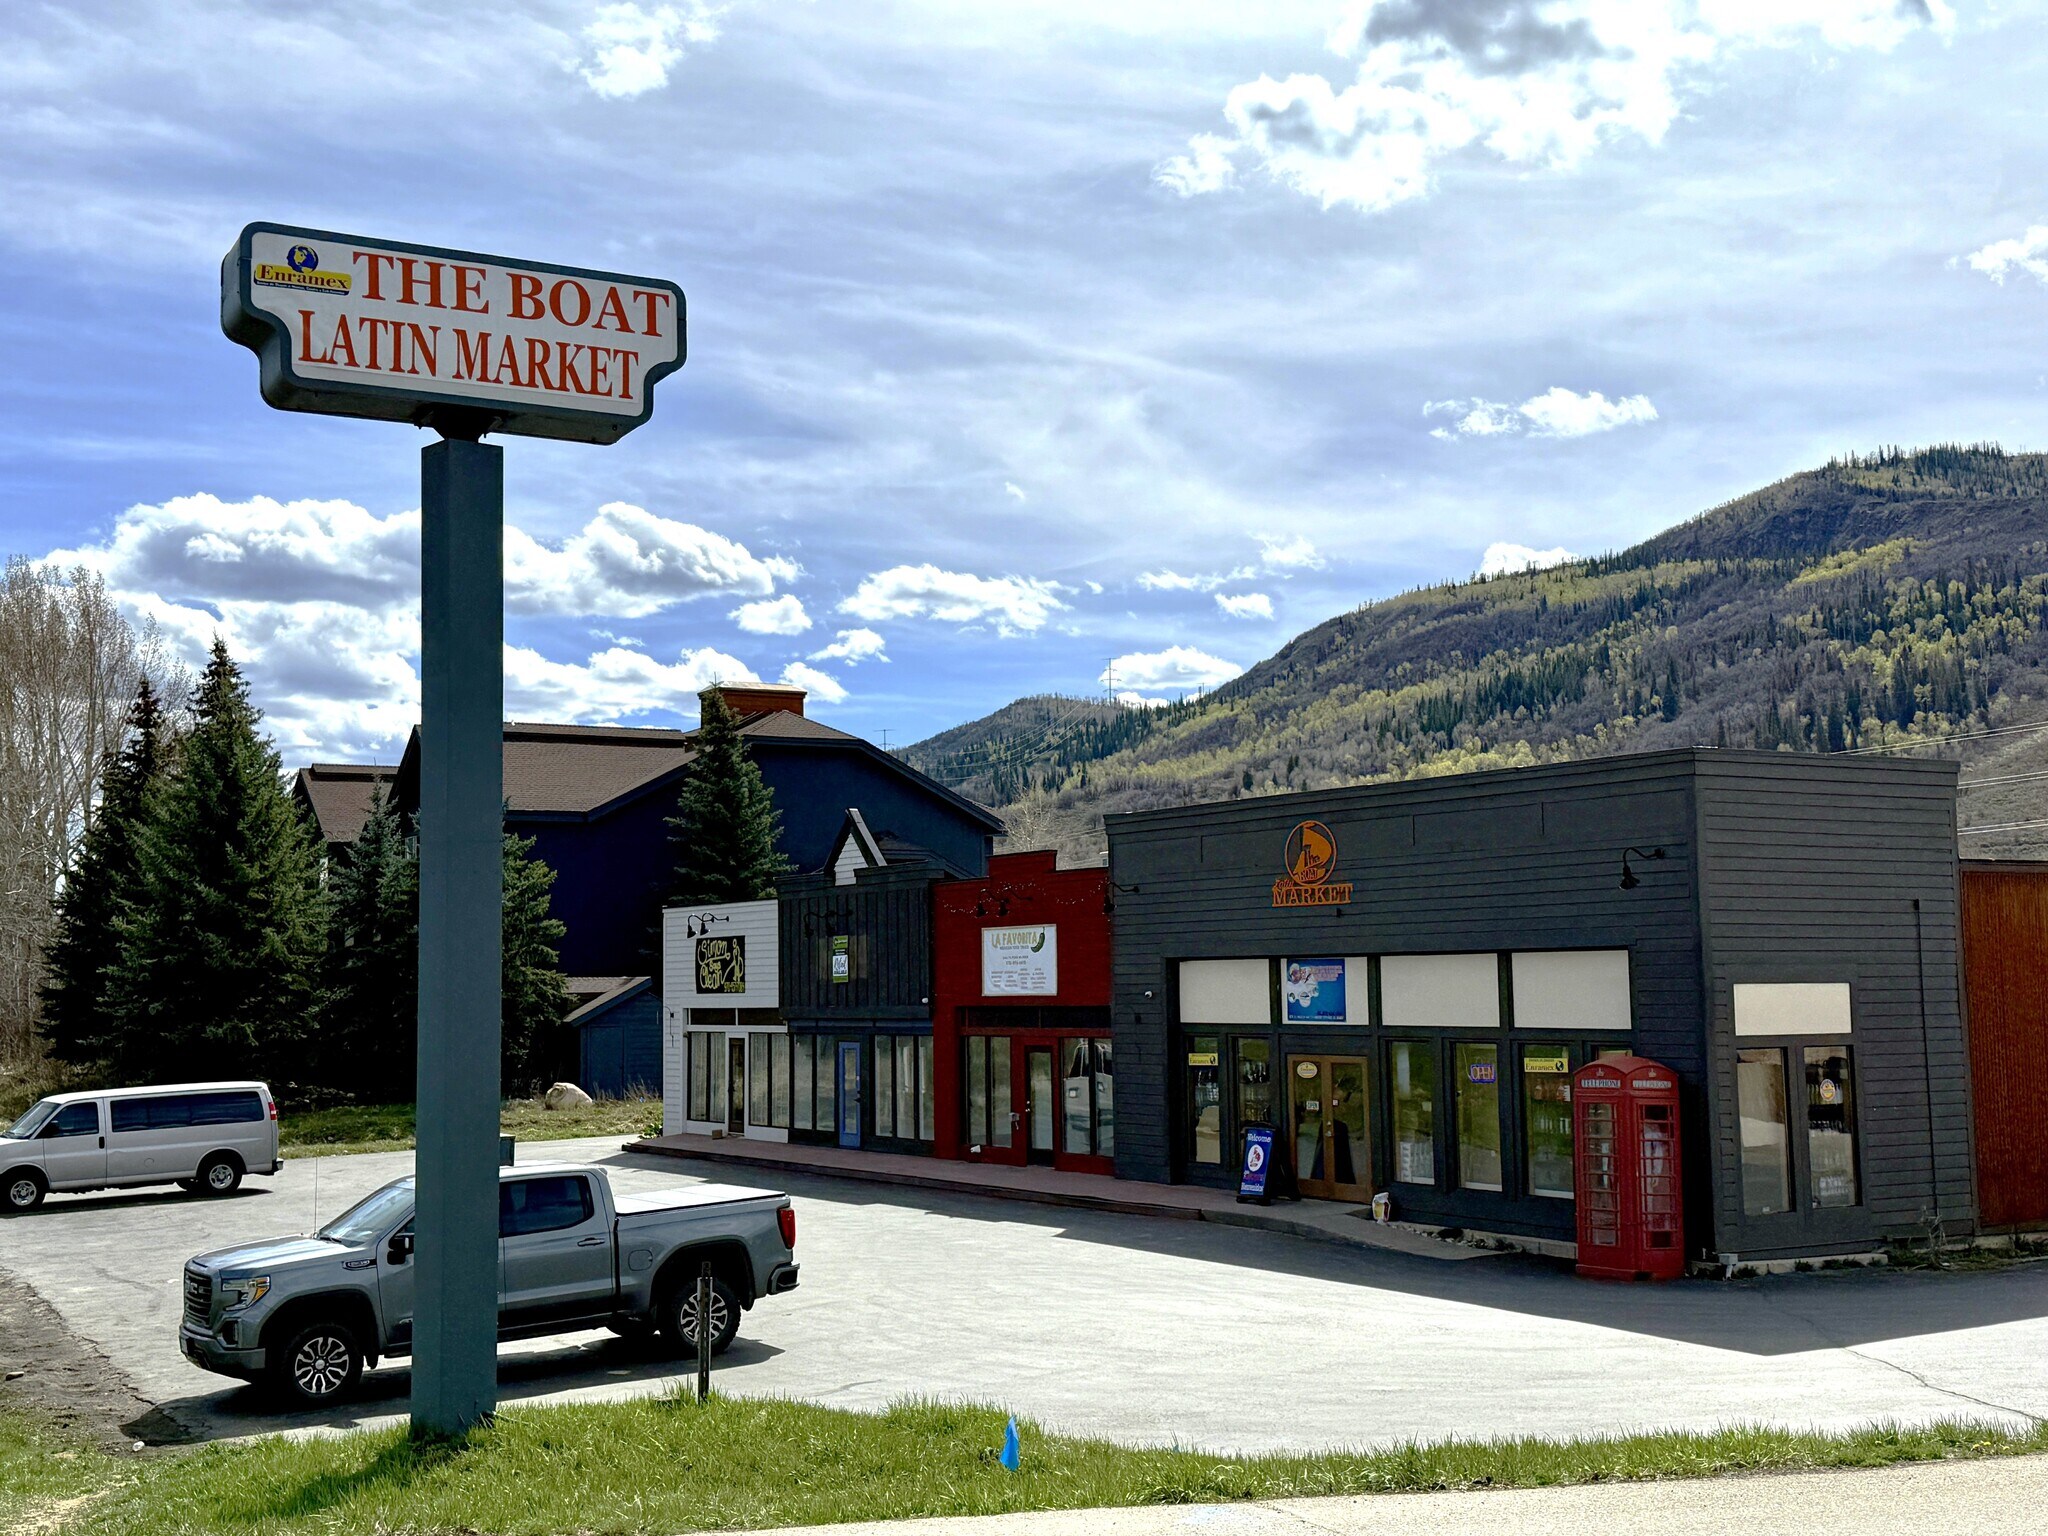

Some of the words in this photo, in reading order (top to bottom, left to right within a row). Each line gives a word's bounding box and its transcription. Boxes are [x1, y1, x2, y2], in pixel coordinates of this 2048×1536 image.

[260, 264, 348, 290] Enramex
[353, 251, 489, 315] THE
[507, 272, 669, 338] BOAT
[297, 309, 441, 377] LATIN
[452, 328, 639, 400] MARKET
[1272, 884, 1353, 907] MARKET
[991, 933, 1001, 949] LA
[1003, 932, 1038, 945] FAVORITA
[698, 940, 728, 965] Simon
[1471, 1066, 1495, 1081] OPEN
[1582, 1079, 1620, 1089] TELEPHONE
[1247, 1133, 1272, 1144] Welcome
